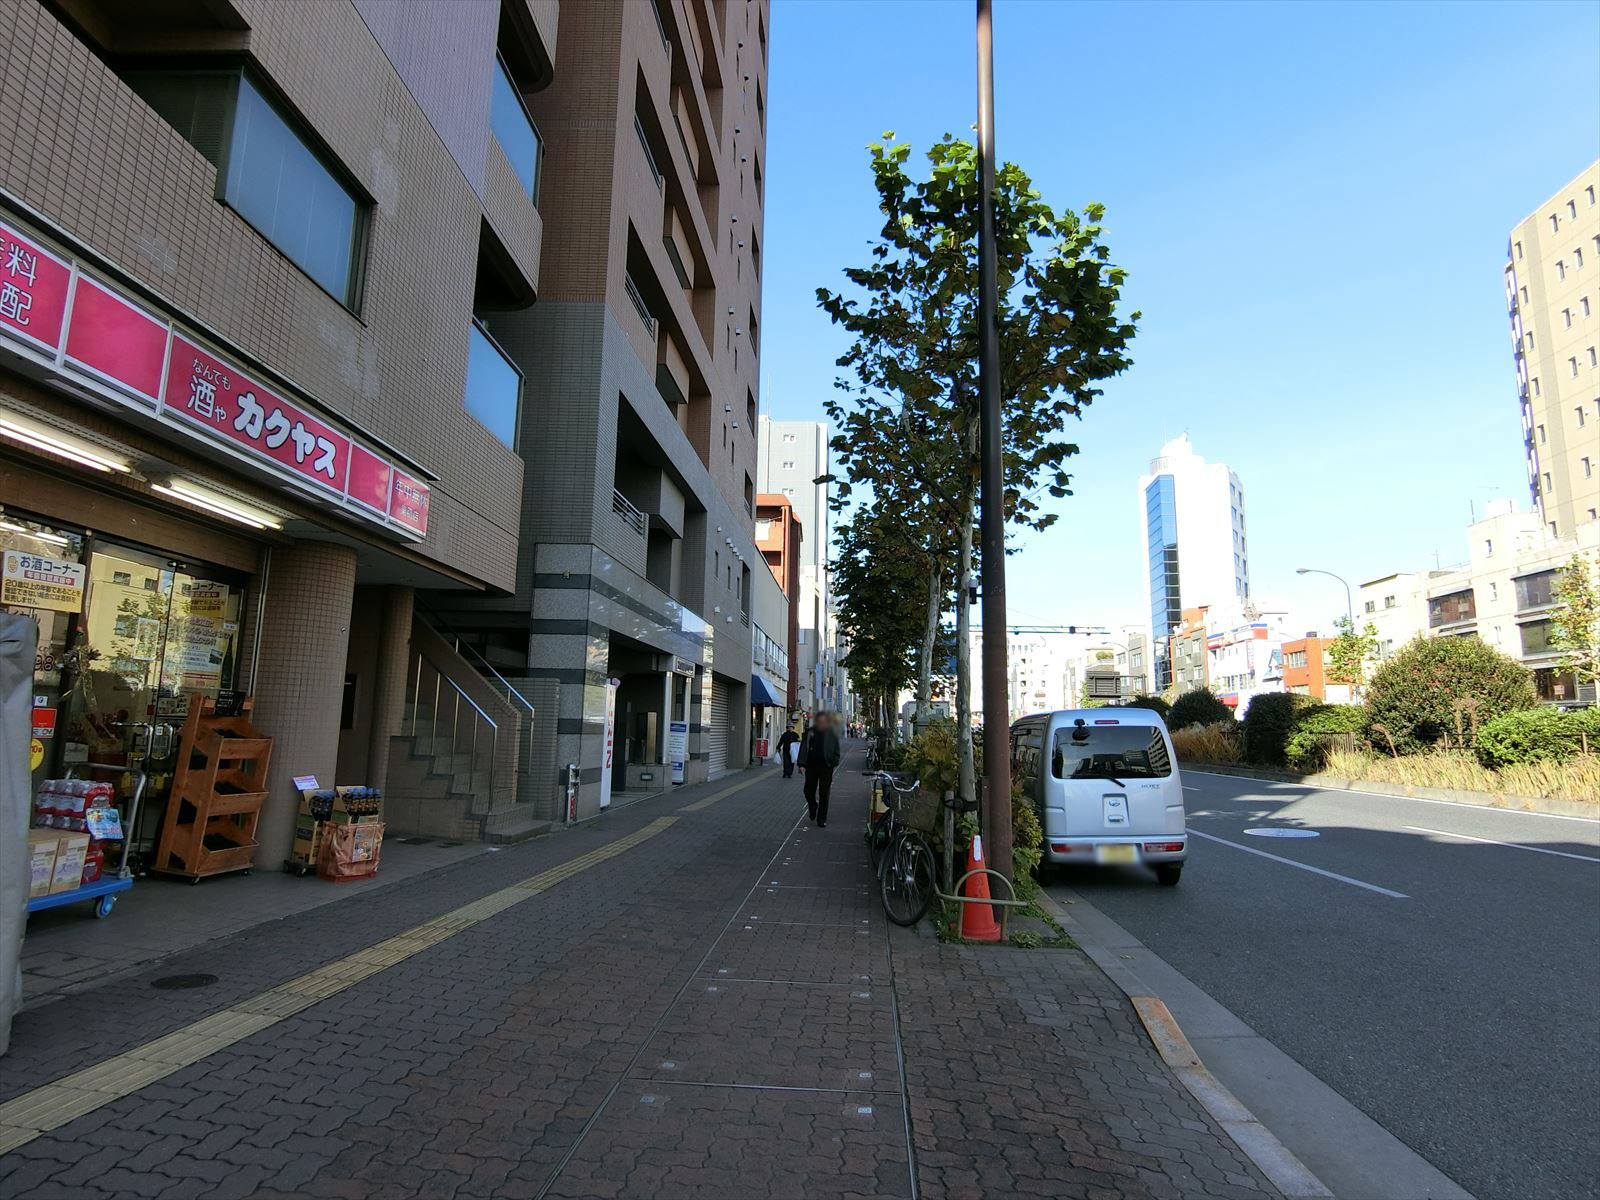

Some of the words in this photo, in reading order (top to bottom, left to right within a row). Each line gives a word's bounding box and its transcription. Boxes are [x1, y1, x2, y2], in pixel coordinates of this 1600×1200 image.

[233, 392, 336, 479] カクヤス
[20, 556, 80, 574] お酒コーナー
